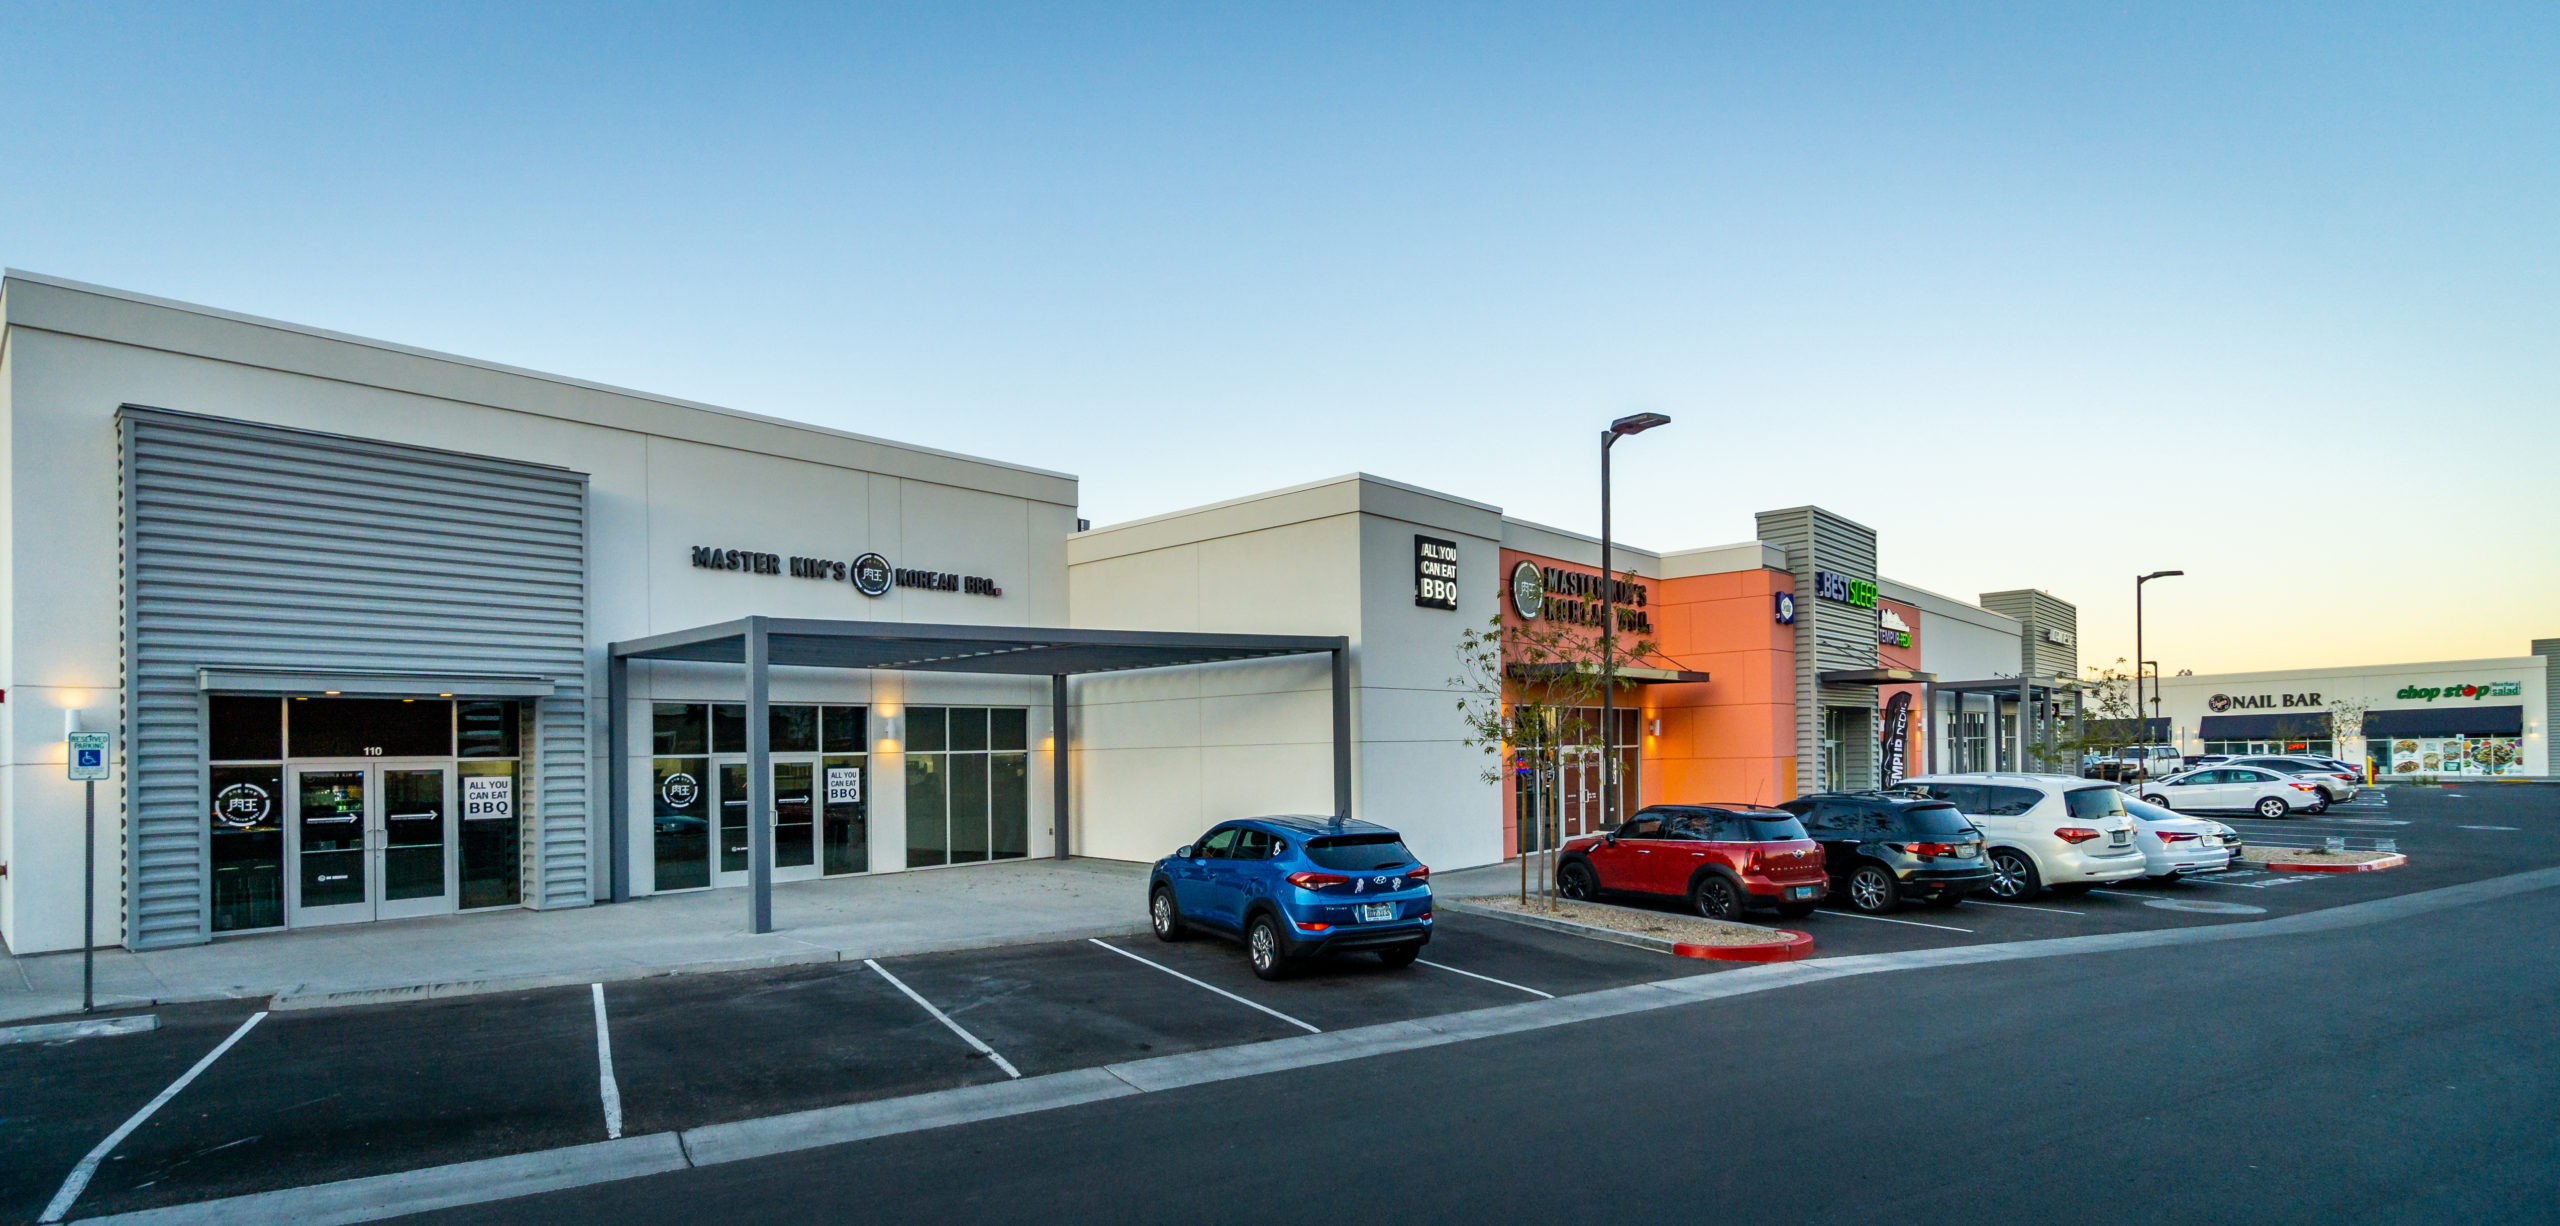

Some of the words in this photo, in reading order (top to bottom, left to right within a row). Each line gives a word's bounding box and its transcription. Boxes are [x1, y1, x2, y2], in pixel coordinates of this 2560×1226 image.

[1421, 543, 1438, 558] ALL
[1438, 545, 1457, 562] YOU
[692, 545, 781, 575] MASTER
[790, 556, 847, 582] KIM'S
[895, 568, 960, 592] KOREAN
[1421, 561, 1440, 577] CAN
[1441, 563, 1457, 579] EAT
[1421, 578, 1457, 606] BBQ
[1544, 567, 1604, 600] MASTER
[1544, 596, 1604, 628] KOREA
[2396, 685, 2442, 702] chop
[2443, 684, 2490, 700] stop
[2492, 686, 2519, 697] salad
[2232, 694, 2277, 709] NAIL
[2282, 692, 2323, 708] BAR
[363, 747, 382, 756] 110
[469, 781, 486, 789] ALL
[489, 780, 508, 789] YOU
[469, 791, 488, 800] CAN
[491, 791, 508, 799] EAT
[830, 788, 857, 799] BBQ
[469, 801, 508, 814] BBQ
